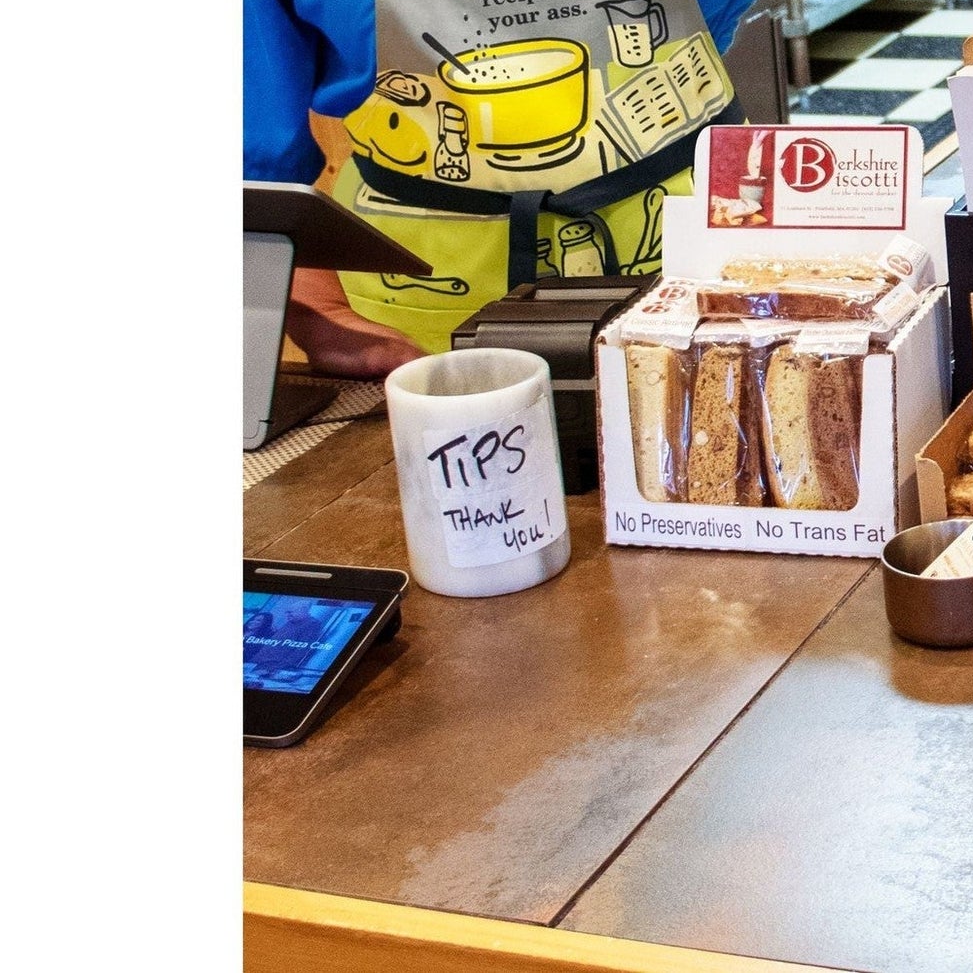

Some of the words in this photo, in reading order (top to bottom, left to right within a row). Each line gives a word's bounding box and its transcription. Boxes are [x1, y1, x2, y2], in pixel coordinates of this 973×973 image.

[488, 11, 540, 34] your
[547, 4, 588, 20] ass.
[443, 498, 525, 533] THANK
[615, 511, 637, 533] No
[641, 513, 742, 539] Preservatives
[755, 520, 783, 538] No
[789, 521, 847, 541] Trans
[853, 524, 886, 543] Fat
[245, 635, 281, 647] Bakery
[281, 638, 309, 648] Pizza
